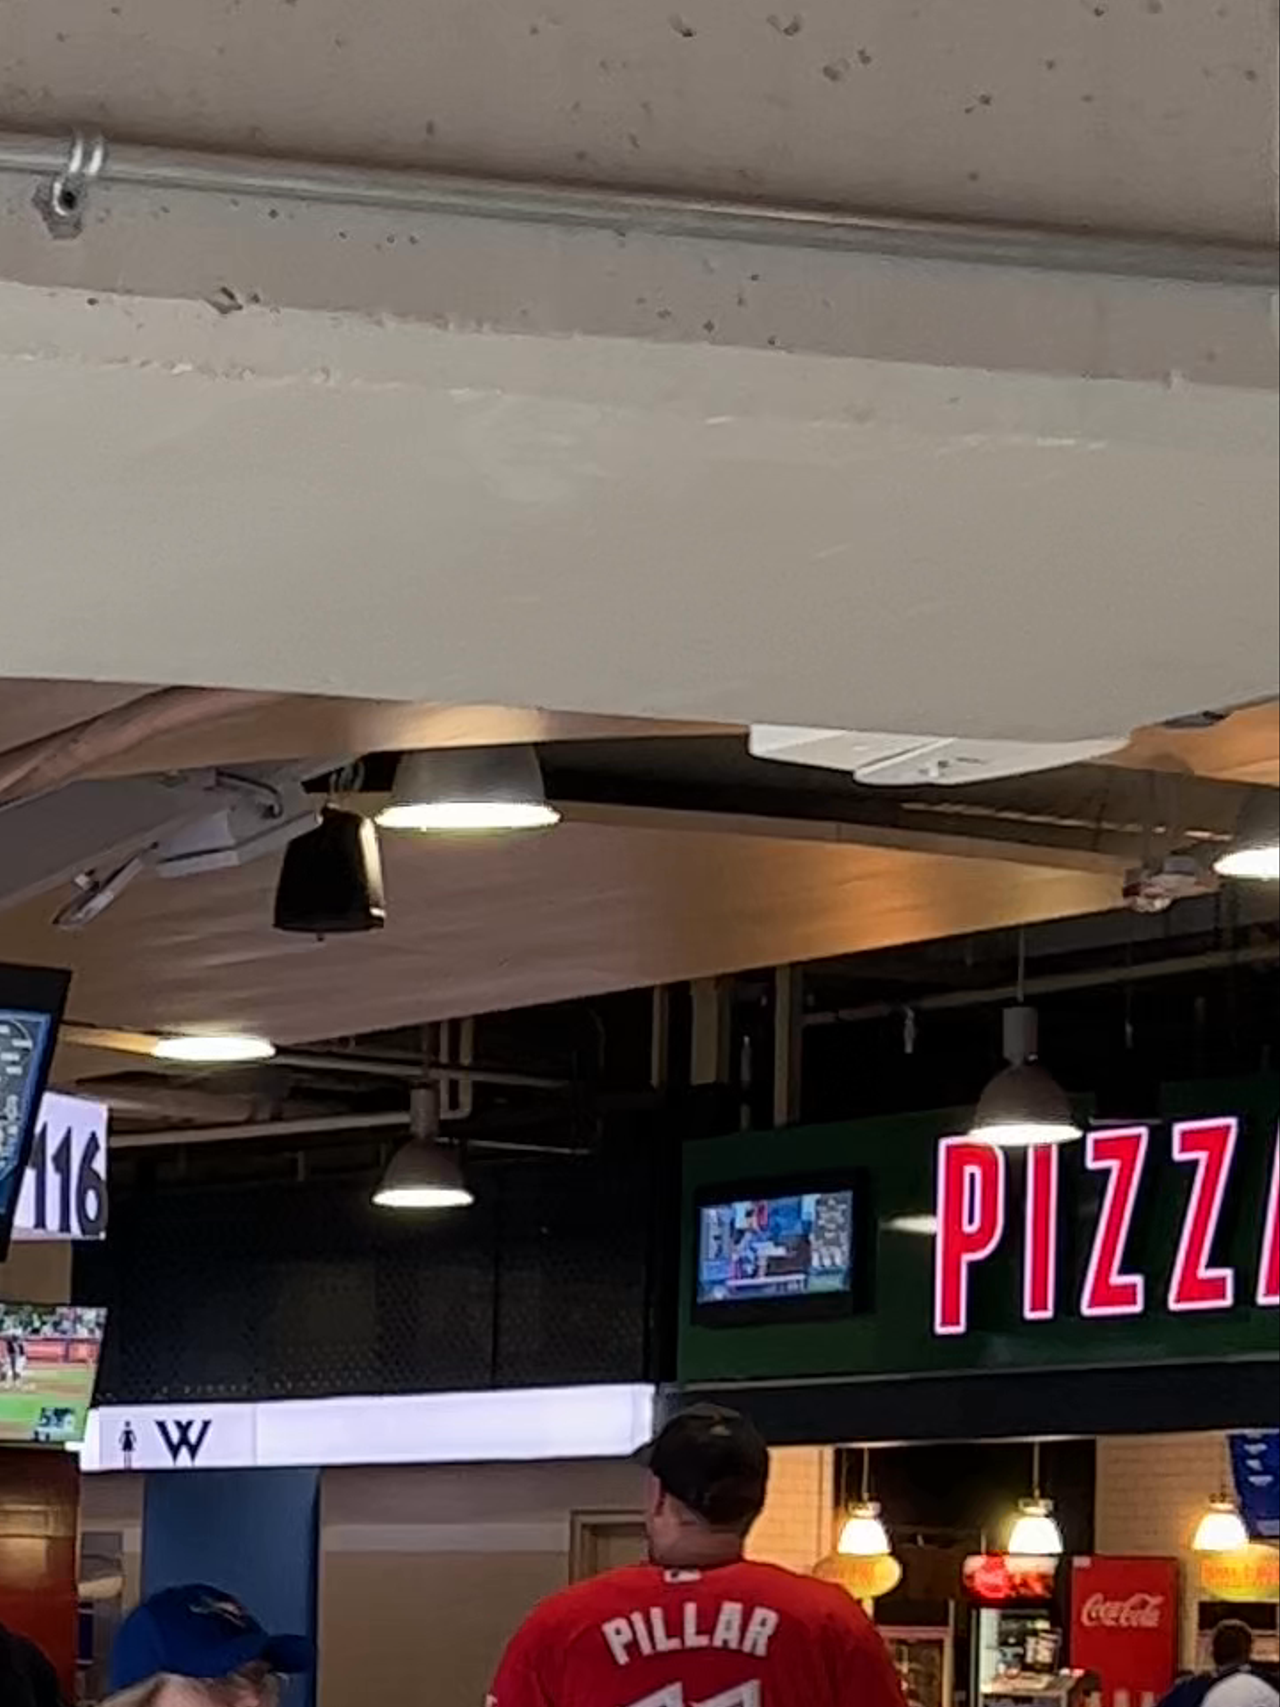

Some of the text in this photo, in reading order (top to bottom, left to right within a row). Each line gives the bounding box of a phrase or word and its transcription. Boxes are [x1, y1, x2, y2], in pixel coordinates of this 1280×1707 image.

[26, 1119, 109, 1238] 116
[153, 1419, 213, 1467] W
[601, 1600, 781, 1666] PILLAR
